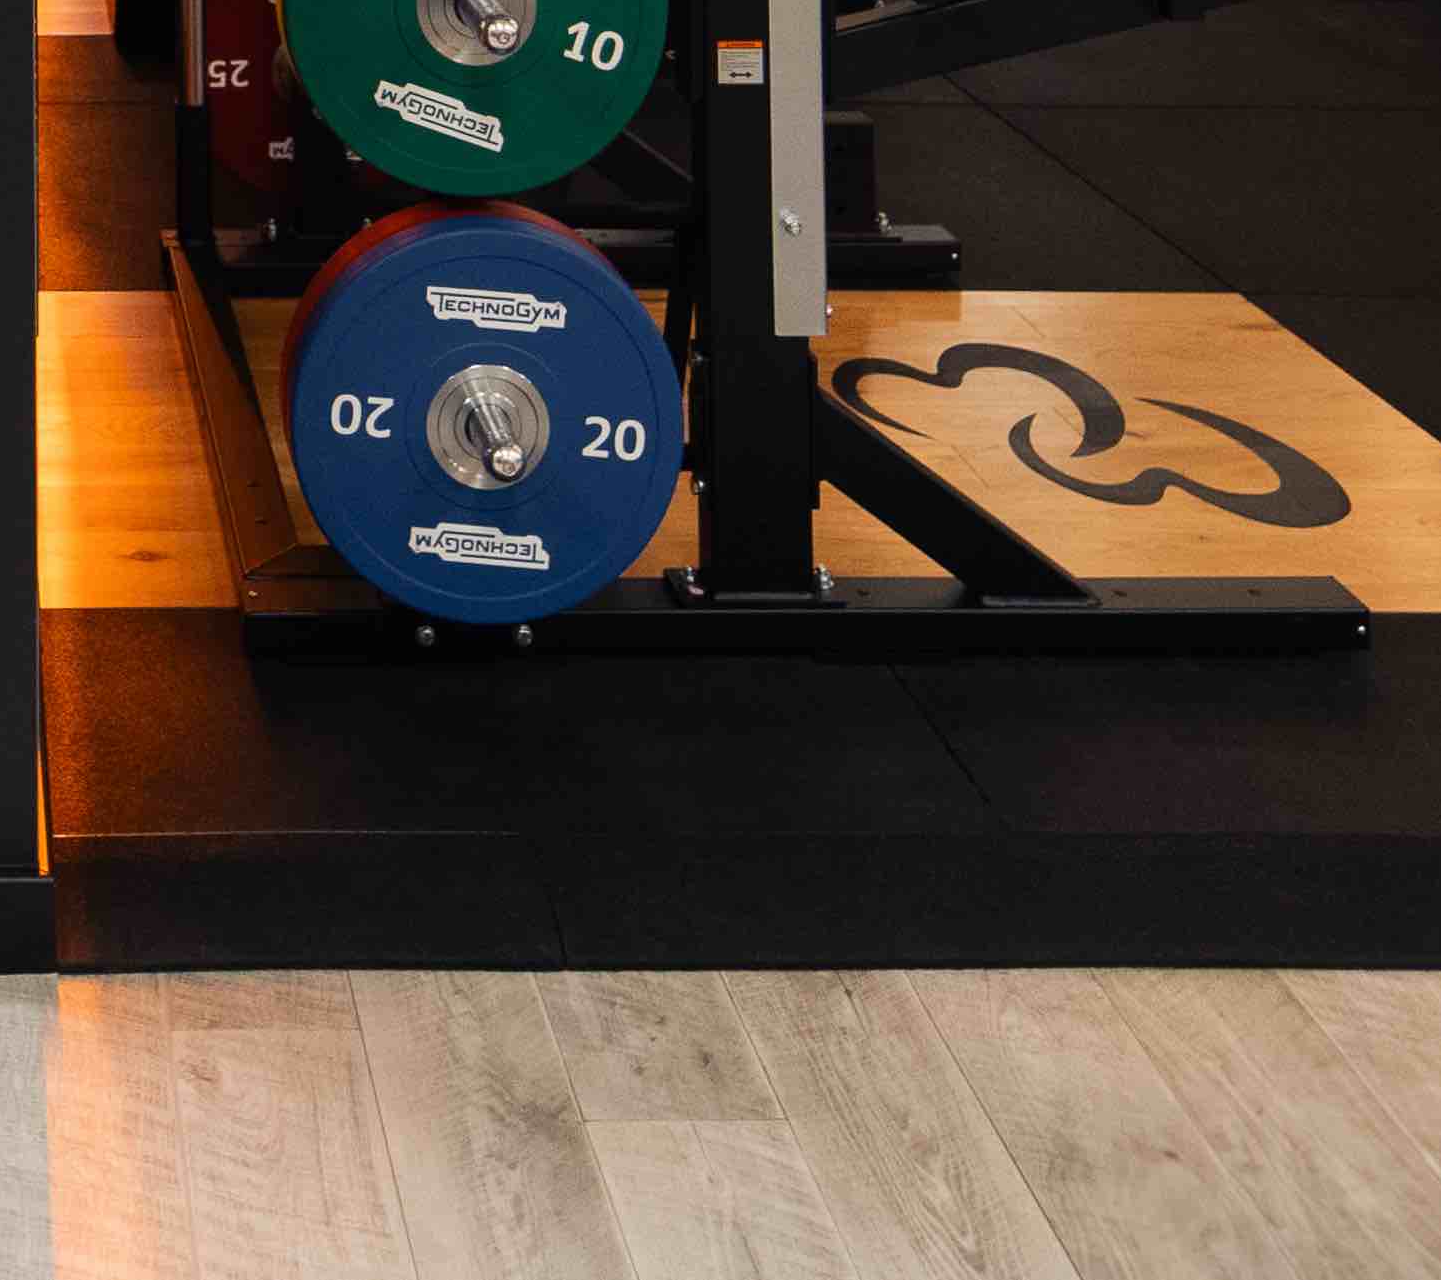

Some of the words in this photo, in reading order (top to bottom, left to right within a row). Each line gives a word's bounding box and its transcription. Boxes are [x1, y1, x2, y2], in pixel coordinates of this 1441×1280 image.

[563, 21, 624, 70] 10
[208, 59, 250, 88] 25
[381, 87, 499, 146] TECHNOGYM
[430, 291, 562, 324] TECHNOGYM
[330, 394, 395, 438] 20
[581, 415, 647, 461] 20
[415, 530, 546, 564] TECHNOGYM
